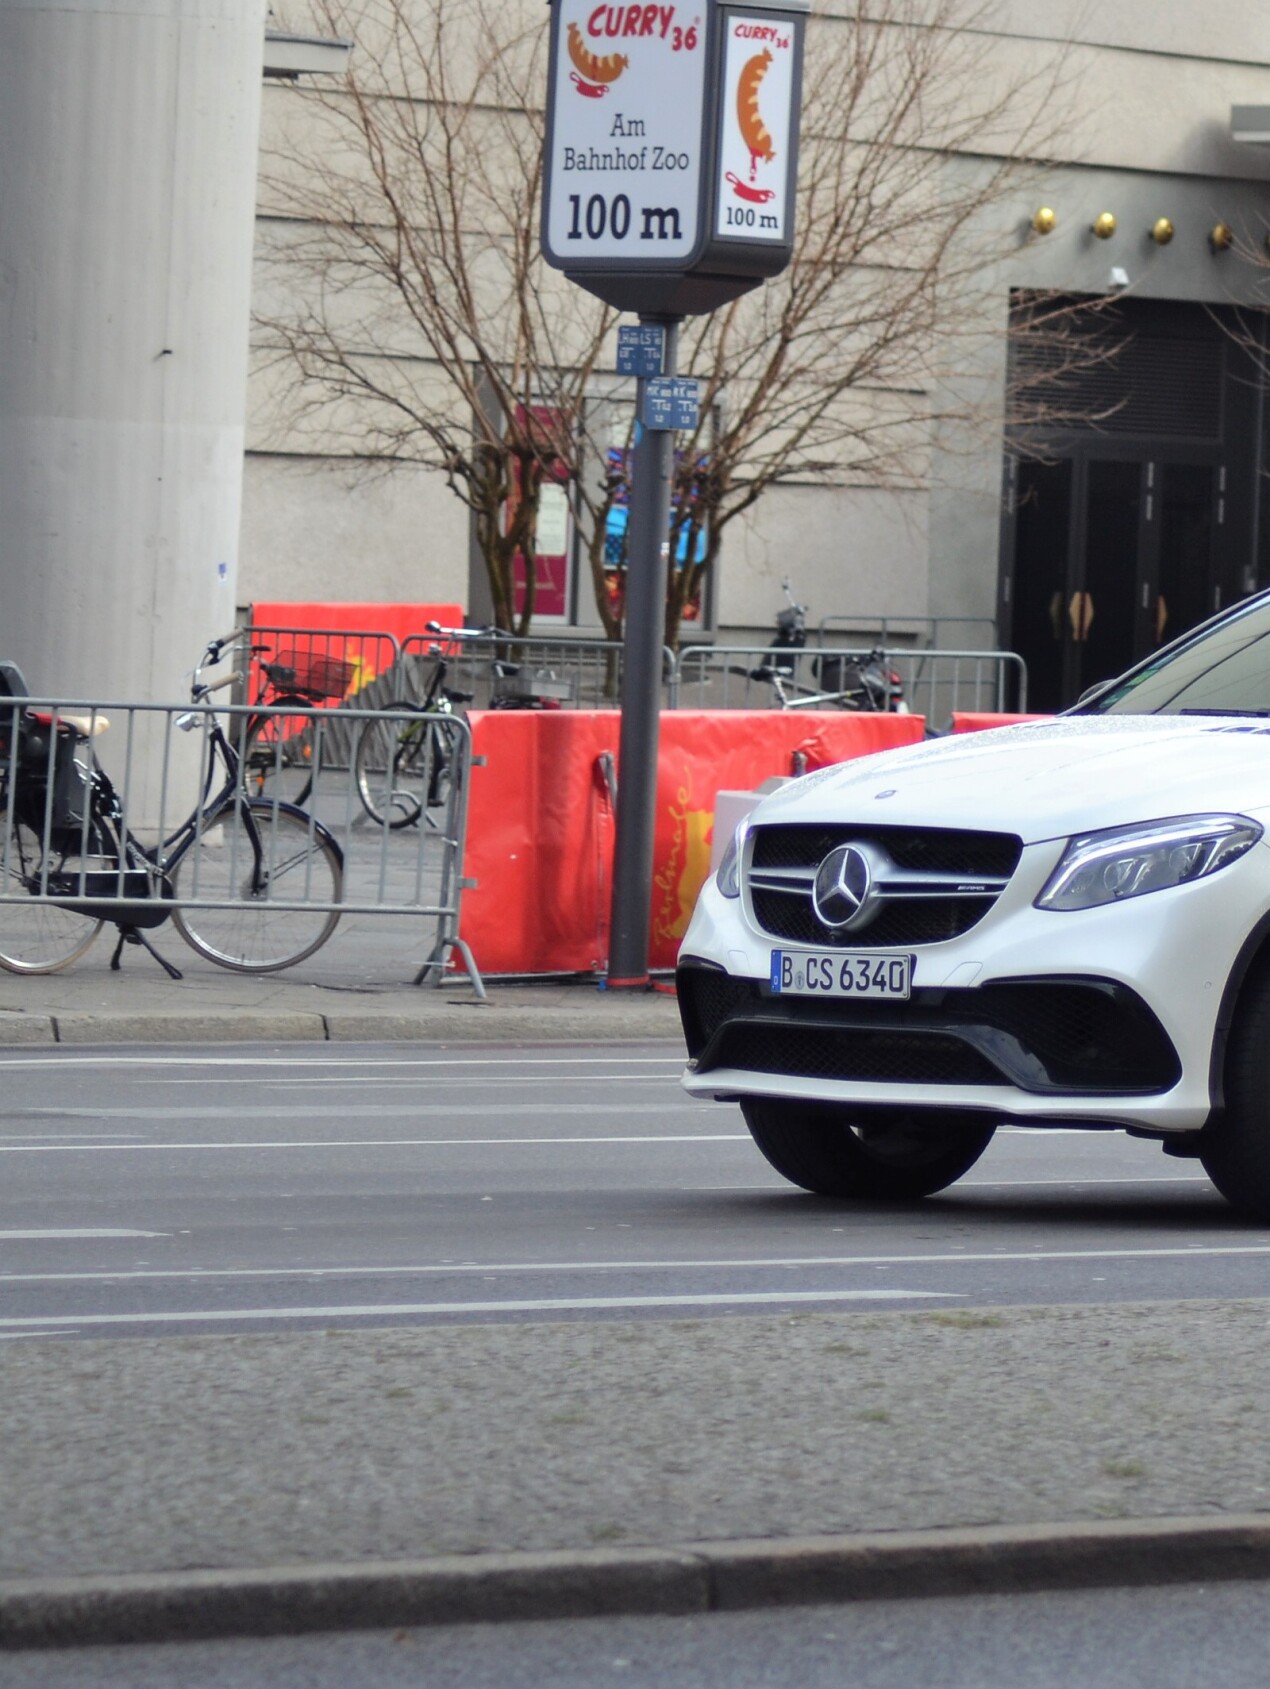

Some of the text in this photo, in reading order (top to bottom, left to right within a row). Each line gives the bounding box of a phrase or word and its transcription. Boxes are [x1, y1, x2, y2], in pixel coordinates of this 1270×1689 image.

[587, 4, 698, 51] CURRY 36
[734, 24, 790, 49] CURRY 36
[609, 113, 646, 137] Am
[563, 146, 690, 171] Bahnhof Zoo
[567, 193, 683, 240] 100 m
[727, 206, 779, 229] 100 m
[781, 956, 793, 988] B
[806, 957, 834, 991] CS
[839, 959, 905, 993] 6340
